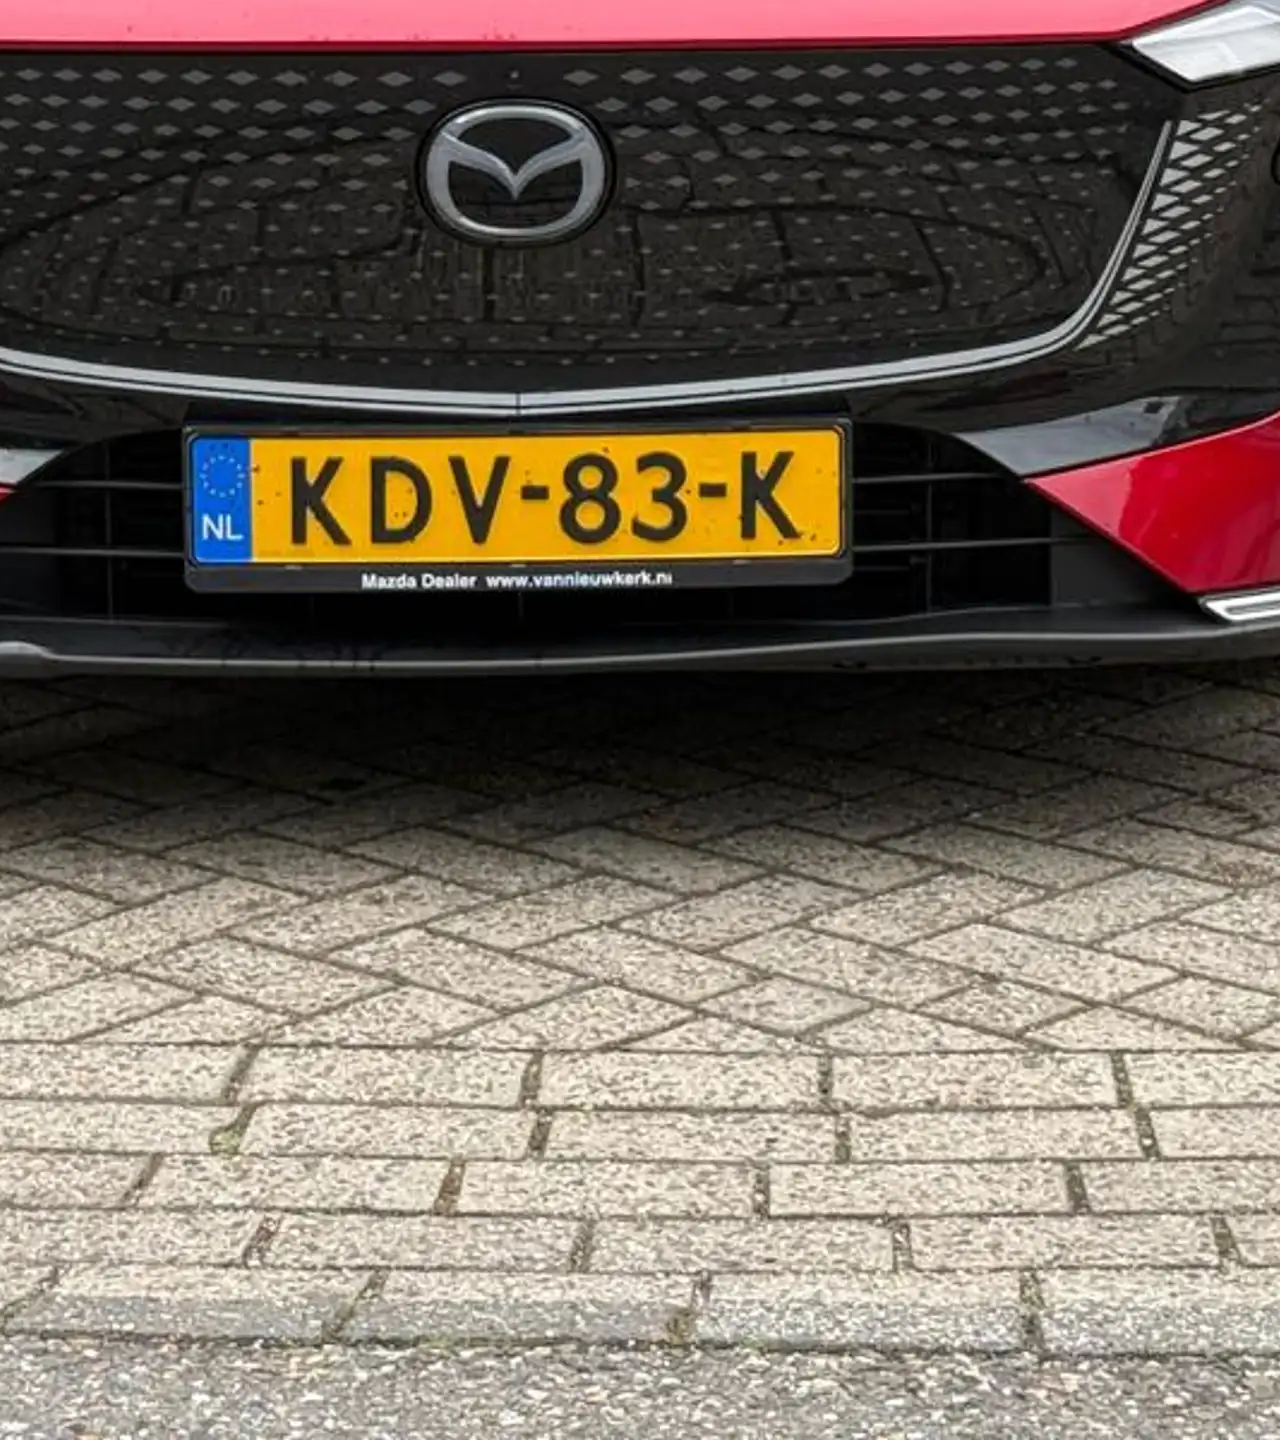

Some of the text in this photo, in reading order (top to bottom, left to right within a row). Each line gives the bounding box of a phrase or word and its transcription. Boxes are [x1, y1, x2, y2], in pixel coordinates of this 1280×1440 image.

[290, 450, 803, 547] KDV-83-K
[202, 514, 244, 541] NL
[360, 572, 418, 590] Mazda
[421, 572, 477, 589] Dealer
